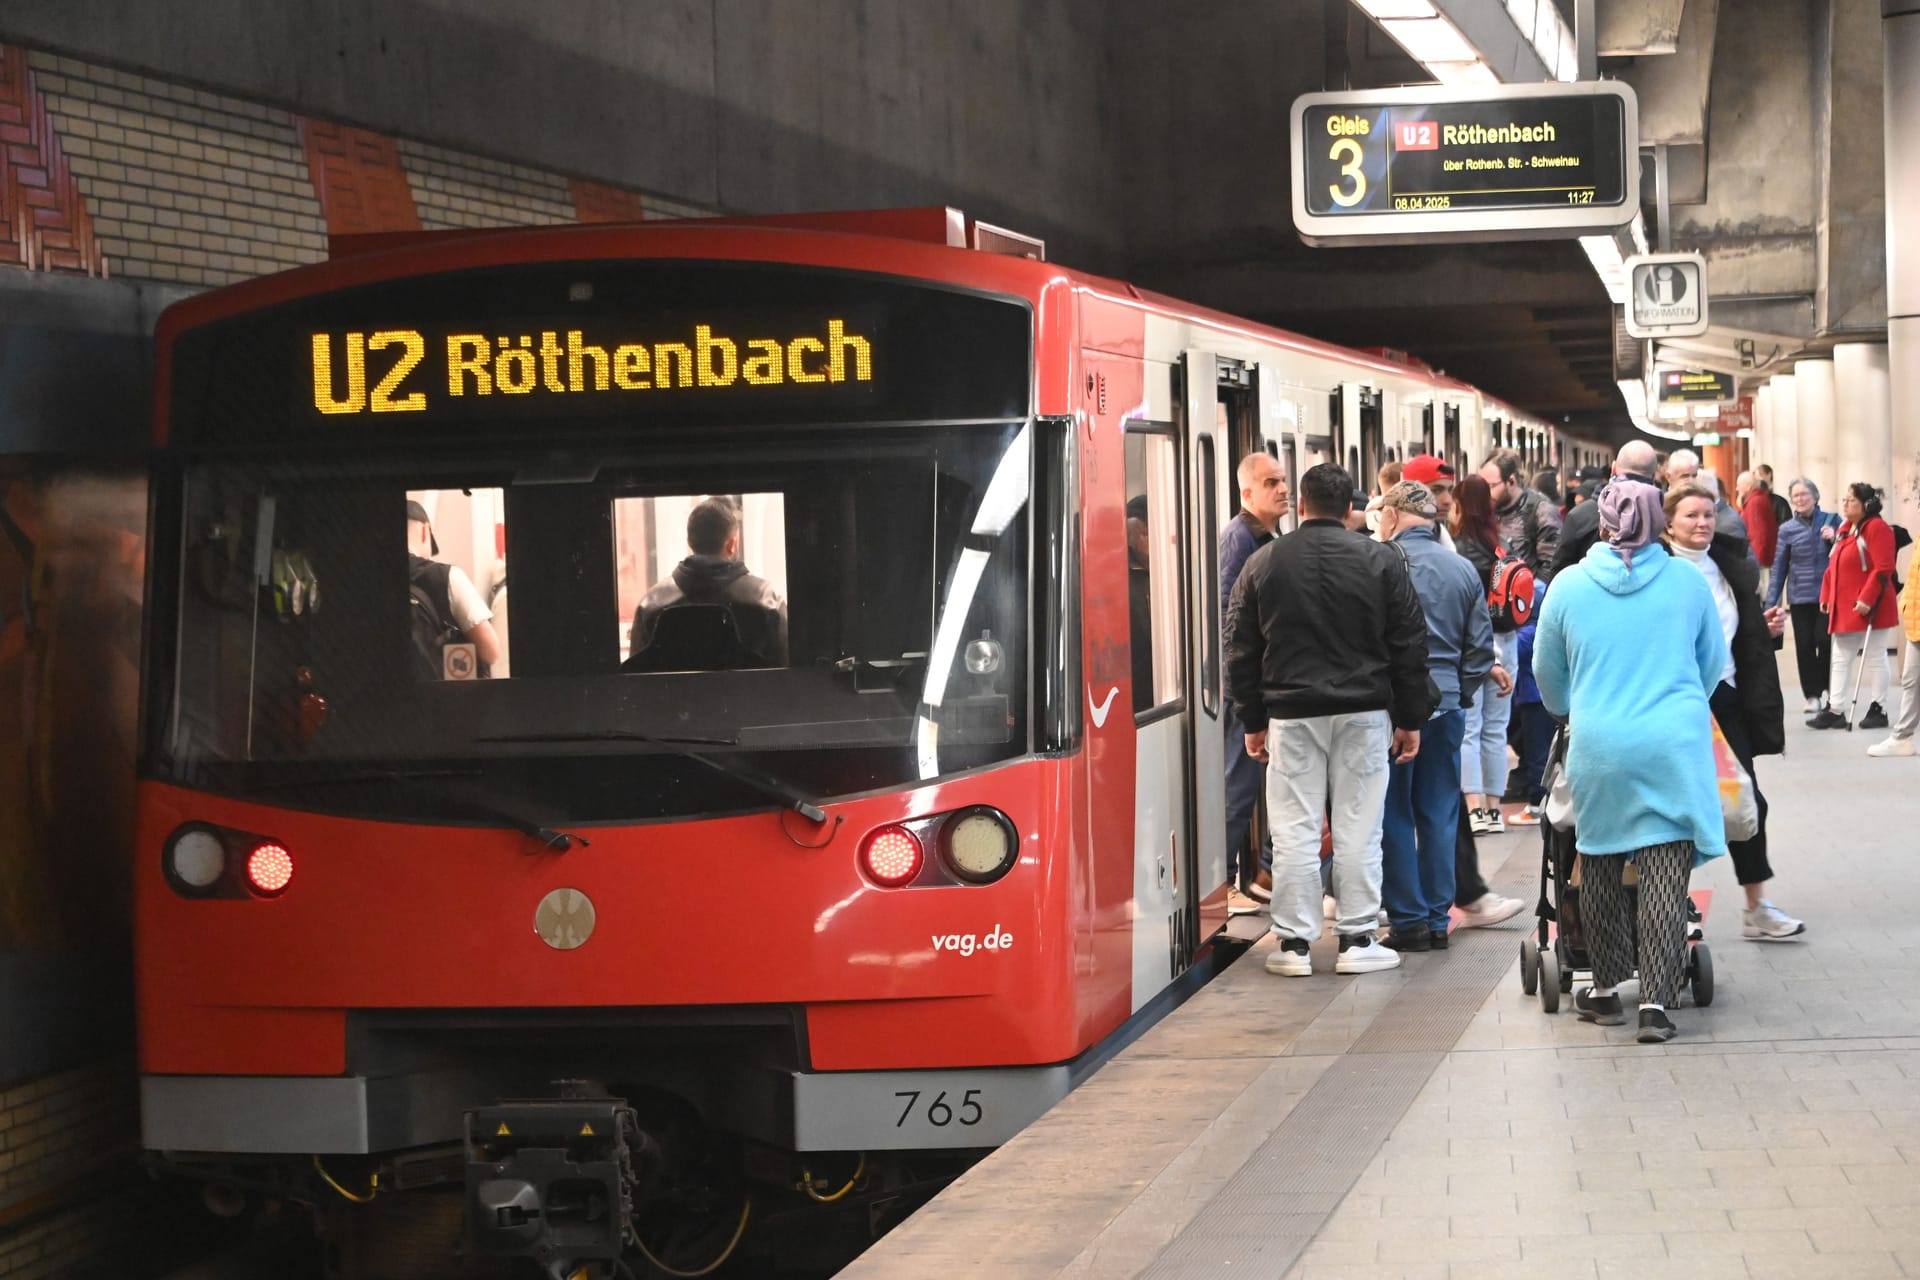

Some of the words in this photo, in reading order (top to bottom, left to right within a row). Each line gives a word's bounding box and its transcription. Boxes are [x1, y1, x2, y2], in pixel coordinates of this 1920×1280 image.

[1327, 115, 1370, 136] Gleis
[1402, 125, 1431, 146] U2
[1443, 121, 1556, 146] Röthenbach
[1329, 138, 1368, 207] 3
[1443, 160, 1464, 172] über
[1466, 157, 1506, 171] Rothenb.
[1508, 156, 1523, 169] Str.
[1531, 154, 1580, 168] Schweinau
[1395, 195, 1451, 210] 08.04.2025
[1568, 191, 1595, 205] 11:27
[312, 330, 427, 415] U2
[446, 319, 873, 397] Röthenbach
[931, 924, 1014, 957] vag.de
[894, 1089, 983, 1128] 765
